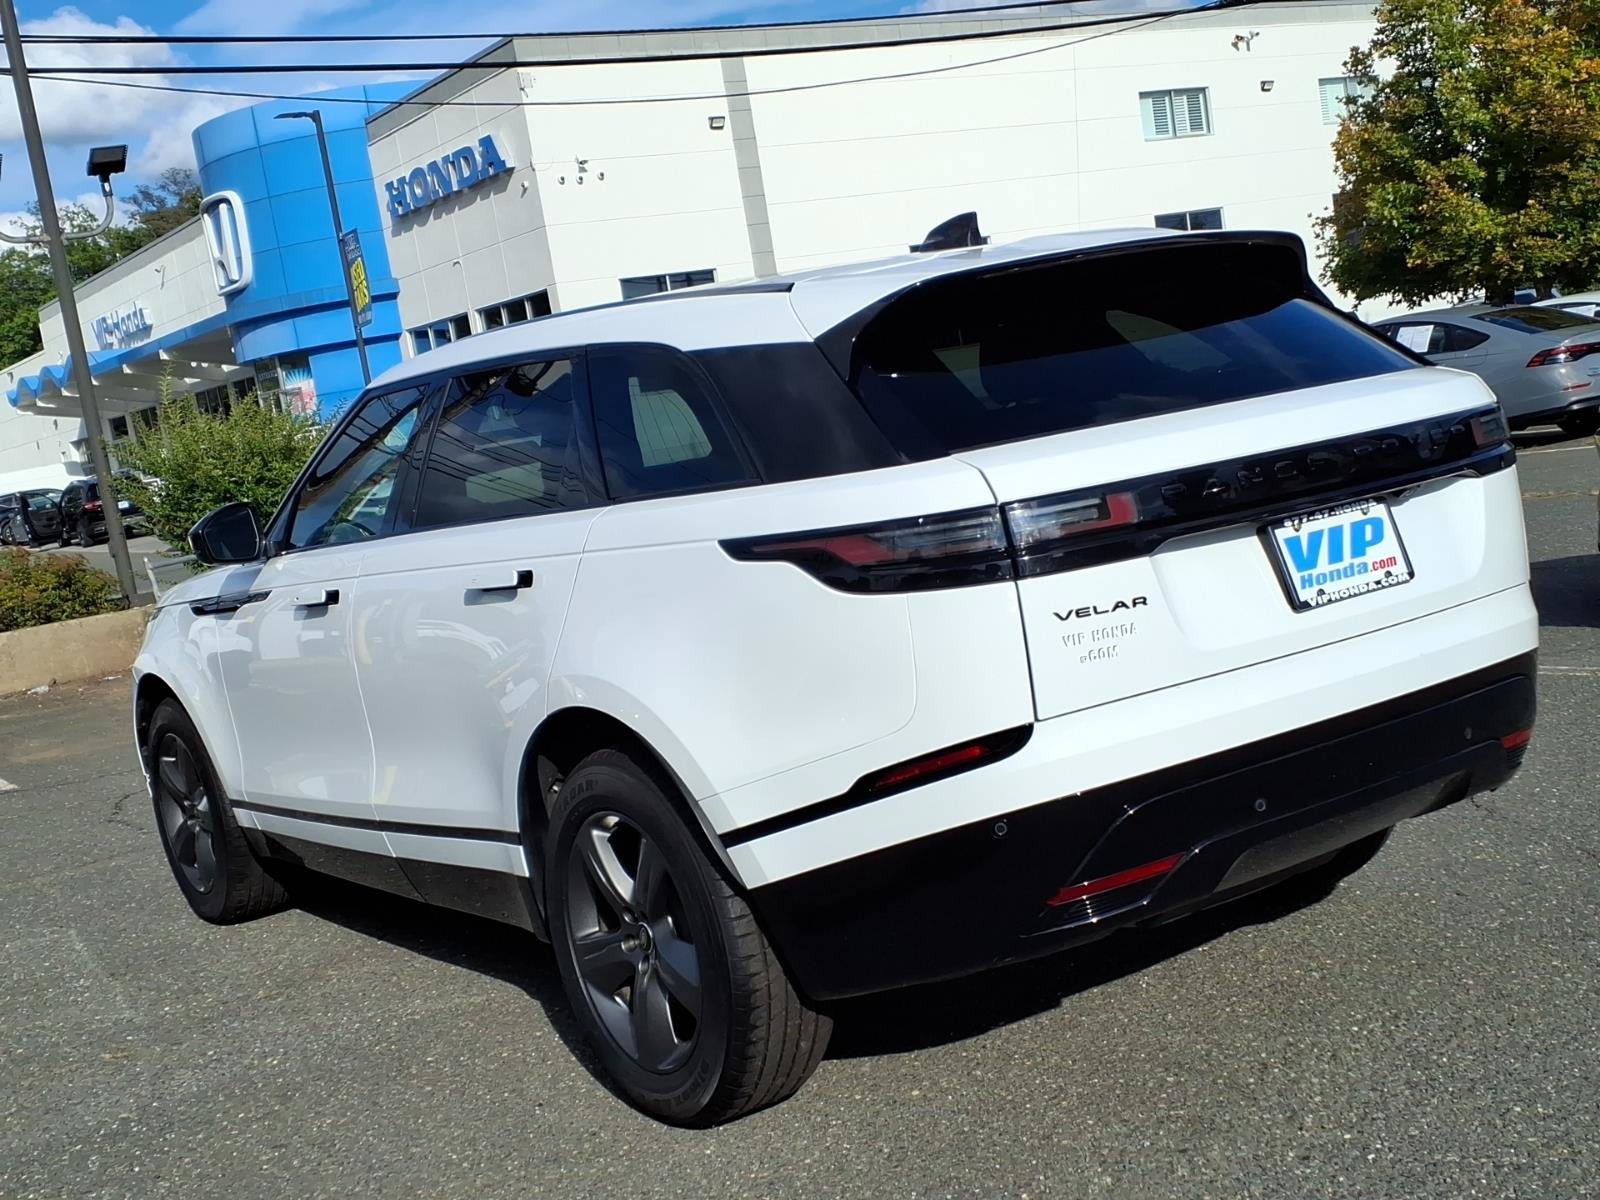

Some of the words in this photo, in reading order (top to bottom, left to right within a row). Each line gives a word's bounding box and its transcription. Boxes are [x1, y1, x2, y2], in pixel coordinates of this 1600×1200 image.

[384, 134, 507, 217] HONDA
[1283, 516, 1385, 573] VIP
[1305, 571, 1410, 607] VIPHONDA.COM
[1053, 596, 1148, 621] VELAR
[1062, 632, 1085, 647] VIP
[1092, 622, 1137, 642] HONDA
